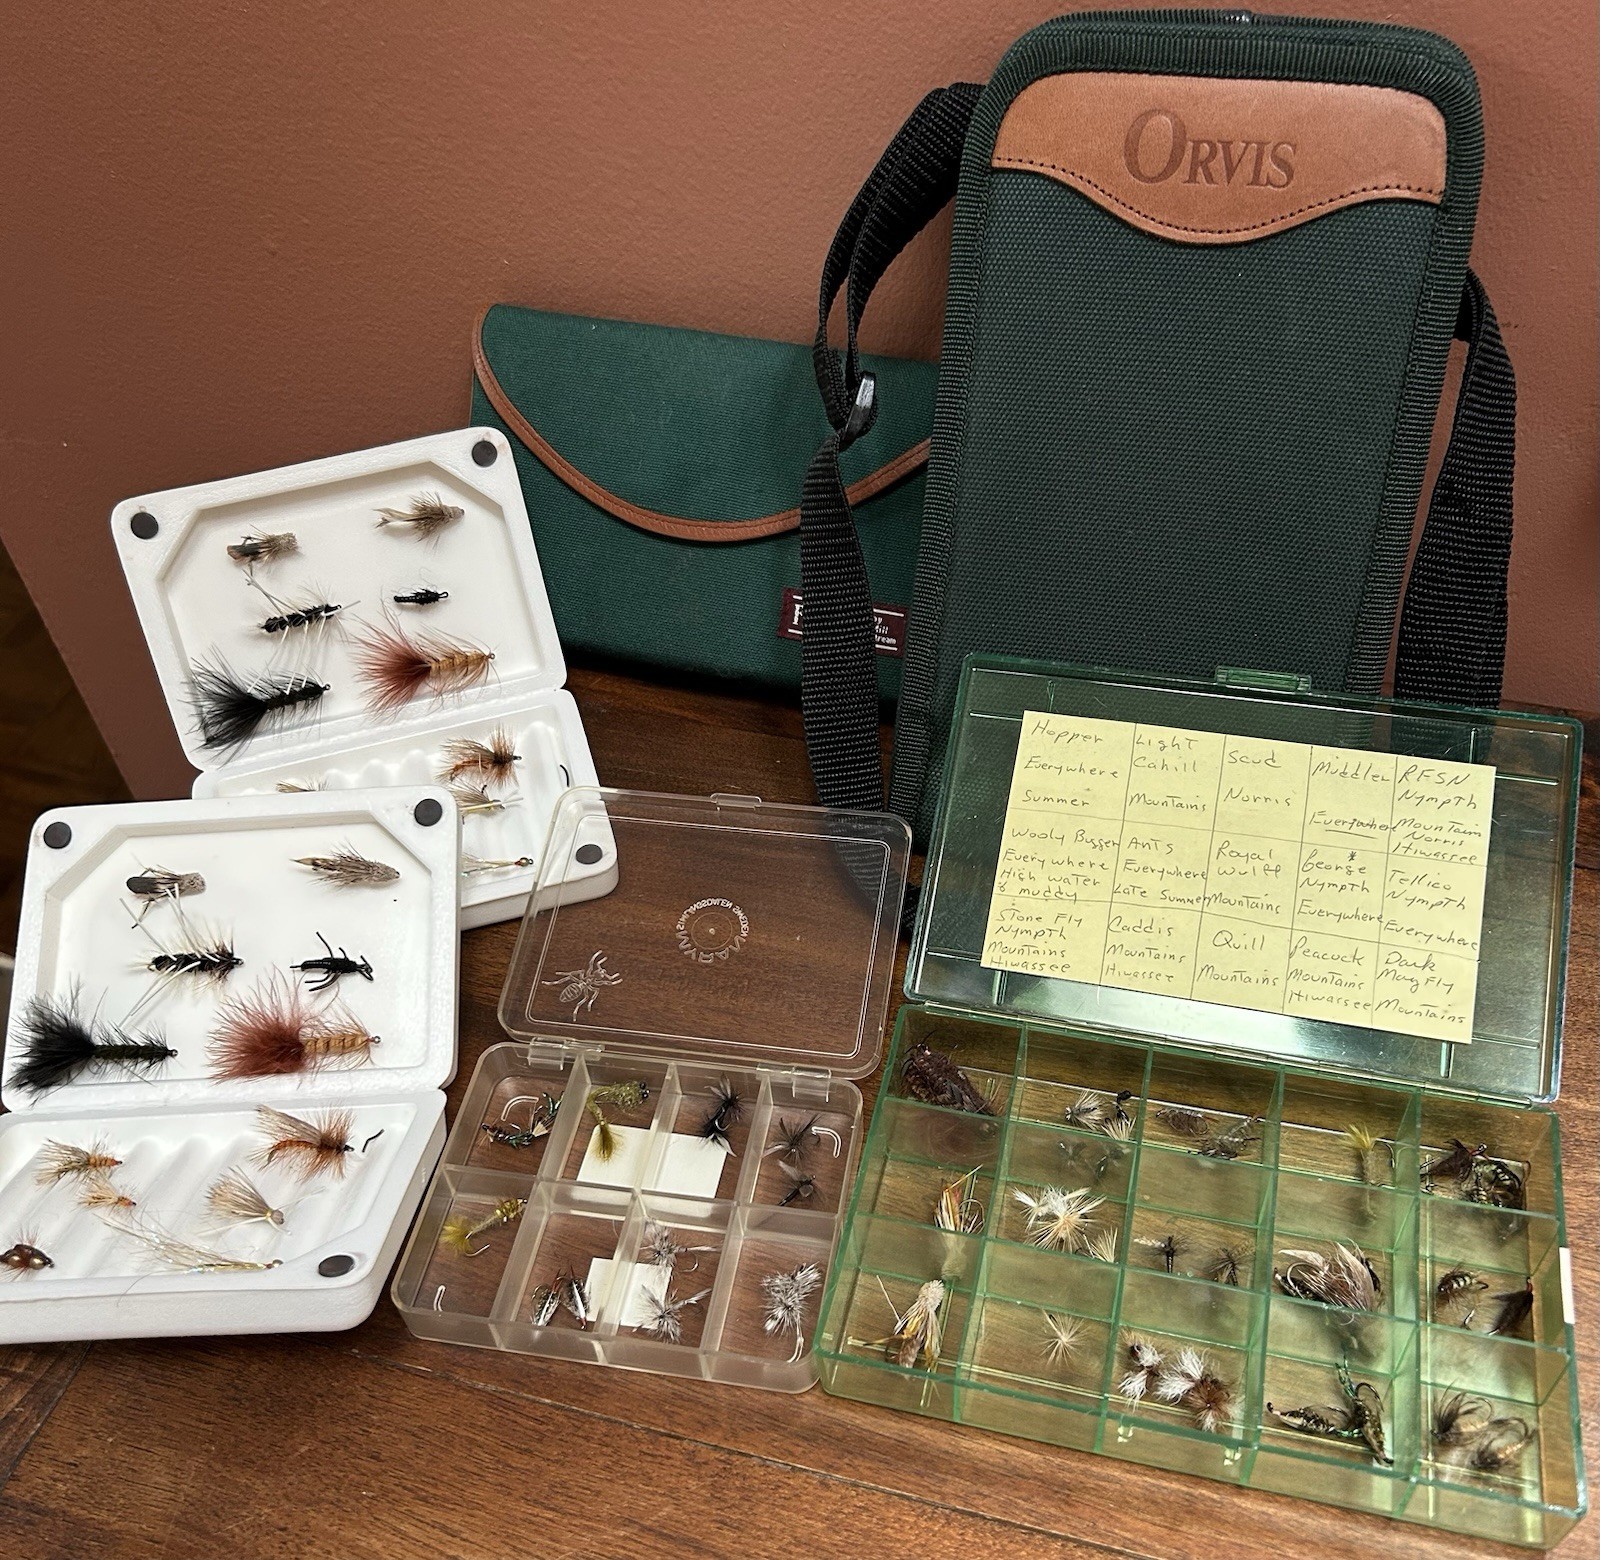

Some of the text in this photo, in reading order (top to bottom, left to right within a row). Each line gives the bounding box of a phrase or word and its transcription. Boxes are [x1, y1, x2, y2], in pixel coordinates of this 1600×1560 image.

[1031, 719, 1103, 744] Hopper
[1024, 755, 1118, 779] Everywhere
[1133, 756, 1197, 773] Cahill
[1228, 750, 1281, 768] Scud
[1022, 789, 1090, 808] Summer
[1224, 786, 1291, 807] Norris
[1012, 828, 1065, 845] Wooly
[1403, 831, 1464, 846] Norris
[1216, 840, 1273, 864] Royal
[1123, 859, 1207, 882] Everywhere
[1389, 869, 1451, 891] Tellico
[1019, 881, 1077, 905] muddy
[1054, 912, 1083, 928] Fly
[1297, 899, 1383, 923] Everywhere
[1107, 915, 1174, 936] Caddis
[1212, 930, 1265, 950] Quill
[1289, 936, 1365, 966] Peacock
[1385, 951, 1436, 971] Dark
